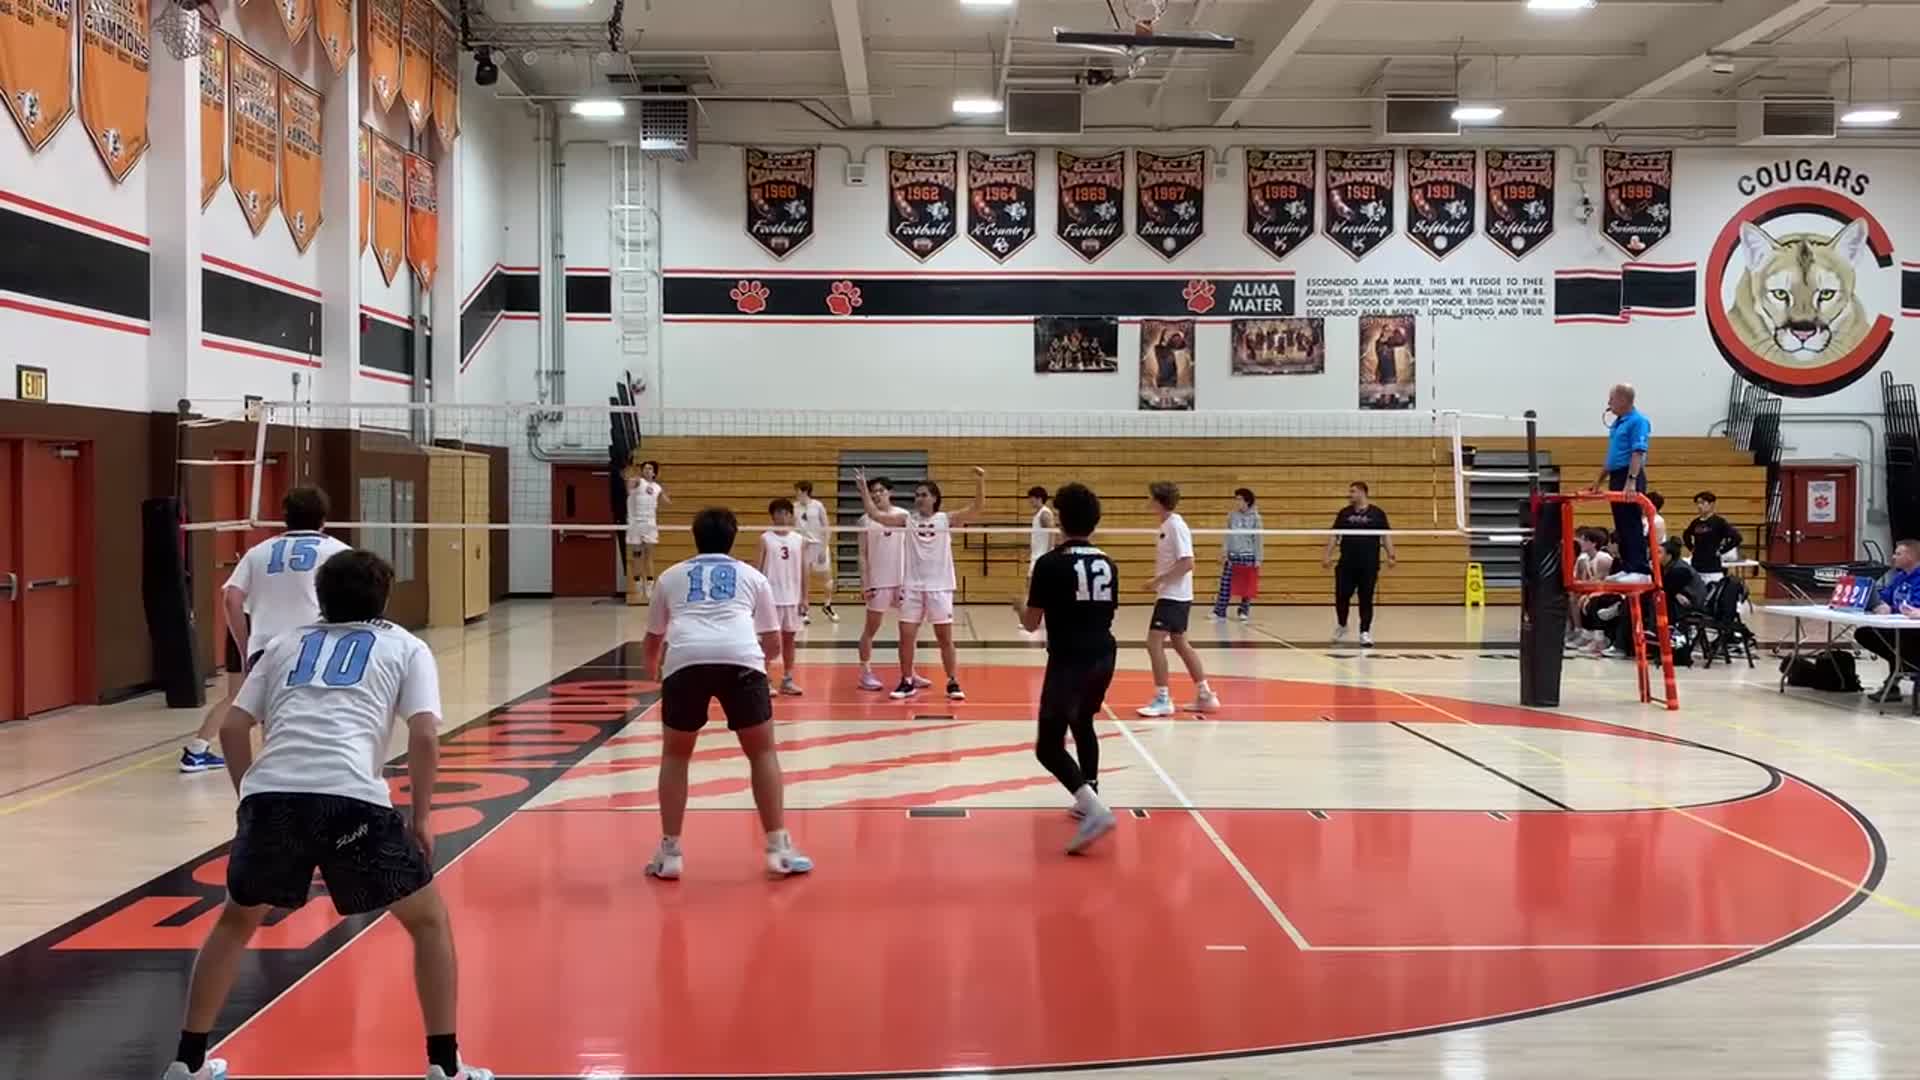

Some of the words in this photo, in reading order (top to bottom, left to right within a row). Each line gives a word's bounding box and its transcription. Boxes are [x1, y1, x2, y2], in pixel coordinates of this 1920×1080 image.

[1738, 158, 1870, 197] COUGARS
[907, 187, 940, 201] 1962
[985, 187, 1017, 201] 1964
[1427, 184, 1455, 198] 1991
[752, 220, 808, 235] Football
[895, 221, 951, 236] Football
[1063, 222, 1117, 237] Football
[1140, 222, 1199, 235] Baseball
[1253, 220, 1309, 236] Wrestling
[1331, 220, 1388, 237] Wrestling
[1412, 220, 1470, 236] Softball
[1490, 219, 1548, 237] Softball
[1608, 220, 1666, 238] Swimming
[1232, 283, 1280, 297] ALMA
[1307, 278, 1358, 287] ESCONDIDO
[1363, 278, 1389, 286] ALMA
[1430, 278, 1447, 286] THIS
[1450, 278, 1464, 286] WE
[1469, 278, 1501, 286] PLEDGE
[1506, 278, 1518, 286] TO
[1306, 288, 1344, 296] FAITHFUL
[1348, 288, 1389, 296] STUDENTS
[1393, 288, 1414, 296] AND
[1459, 288, 1472, 296] WE
[1477, 288, 1502, 296] SHALL
[1507, 288, 1528, 296] EVER
[1228, 298, 1283, 312] MATER
[1348, 298, 1381, 307] SCHOOL
[1397, 298, 1429, 307] HIGHEST
[1497, 298, 1518, 306] NOW
[1306, 308, 1358, 317] ESCONDIDO
[1459, 308, 1495, 316] STRONG
[1498, 308, 1518, 316] AND
[25, 374, 43, 396] EXIT
[266, 538, 321, 574] 15
[779, 545, 790, 561] 3
[1073, 559, 1113, 601] 12
[1832, 584, 1852, 603] 22
[286, 629, 377, 687] 10
